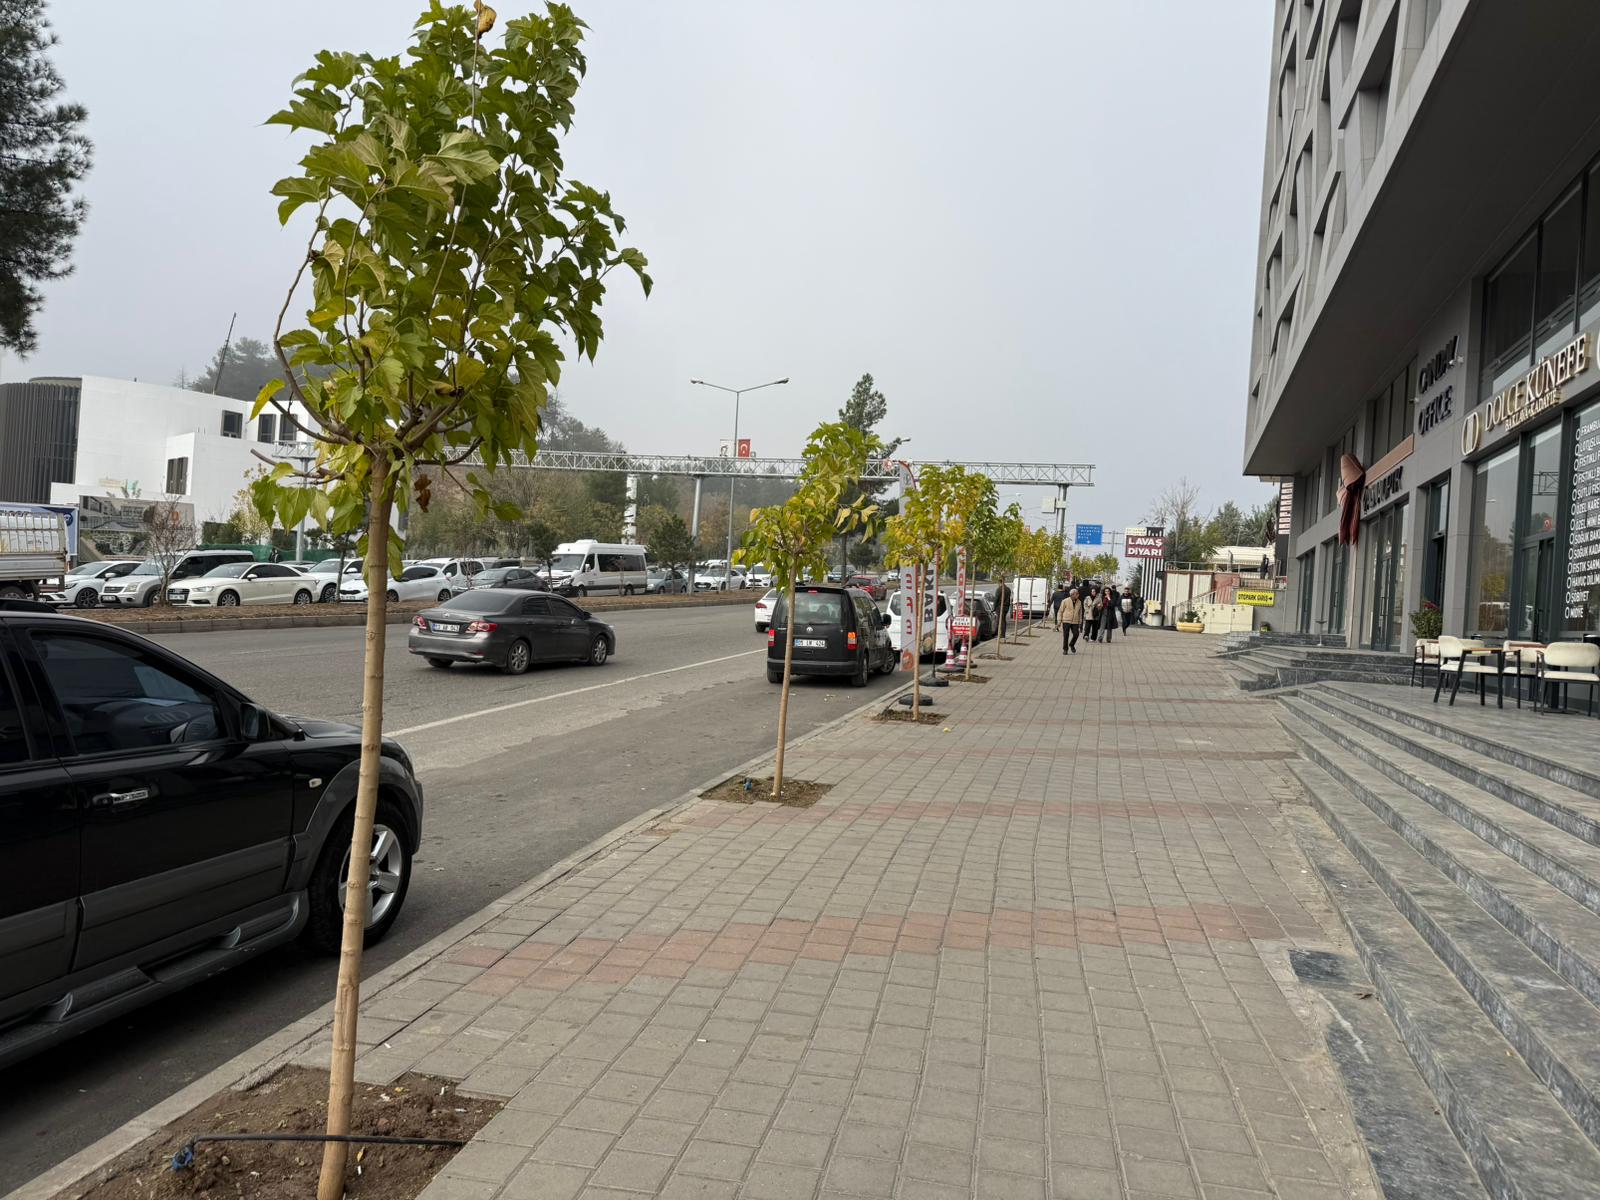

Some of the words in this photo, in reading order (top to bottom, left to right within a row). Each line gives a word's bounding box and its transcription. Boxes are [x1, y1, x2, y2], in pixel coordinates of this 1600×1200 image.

[1484, 379, 1524, 432] DOLCE
[1525, 333, 1588, 402] KÜNEFE
[1128, 537, 1163, 548] LAVAŞ
[1128, 547, 1162, 556] DİYARI
[1238, 593, 1256, 601] OTOPARK
